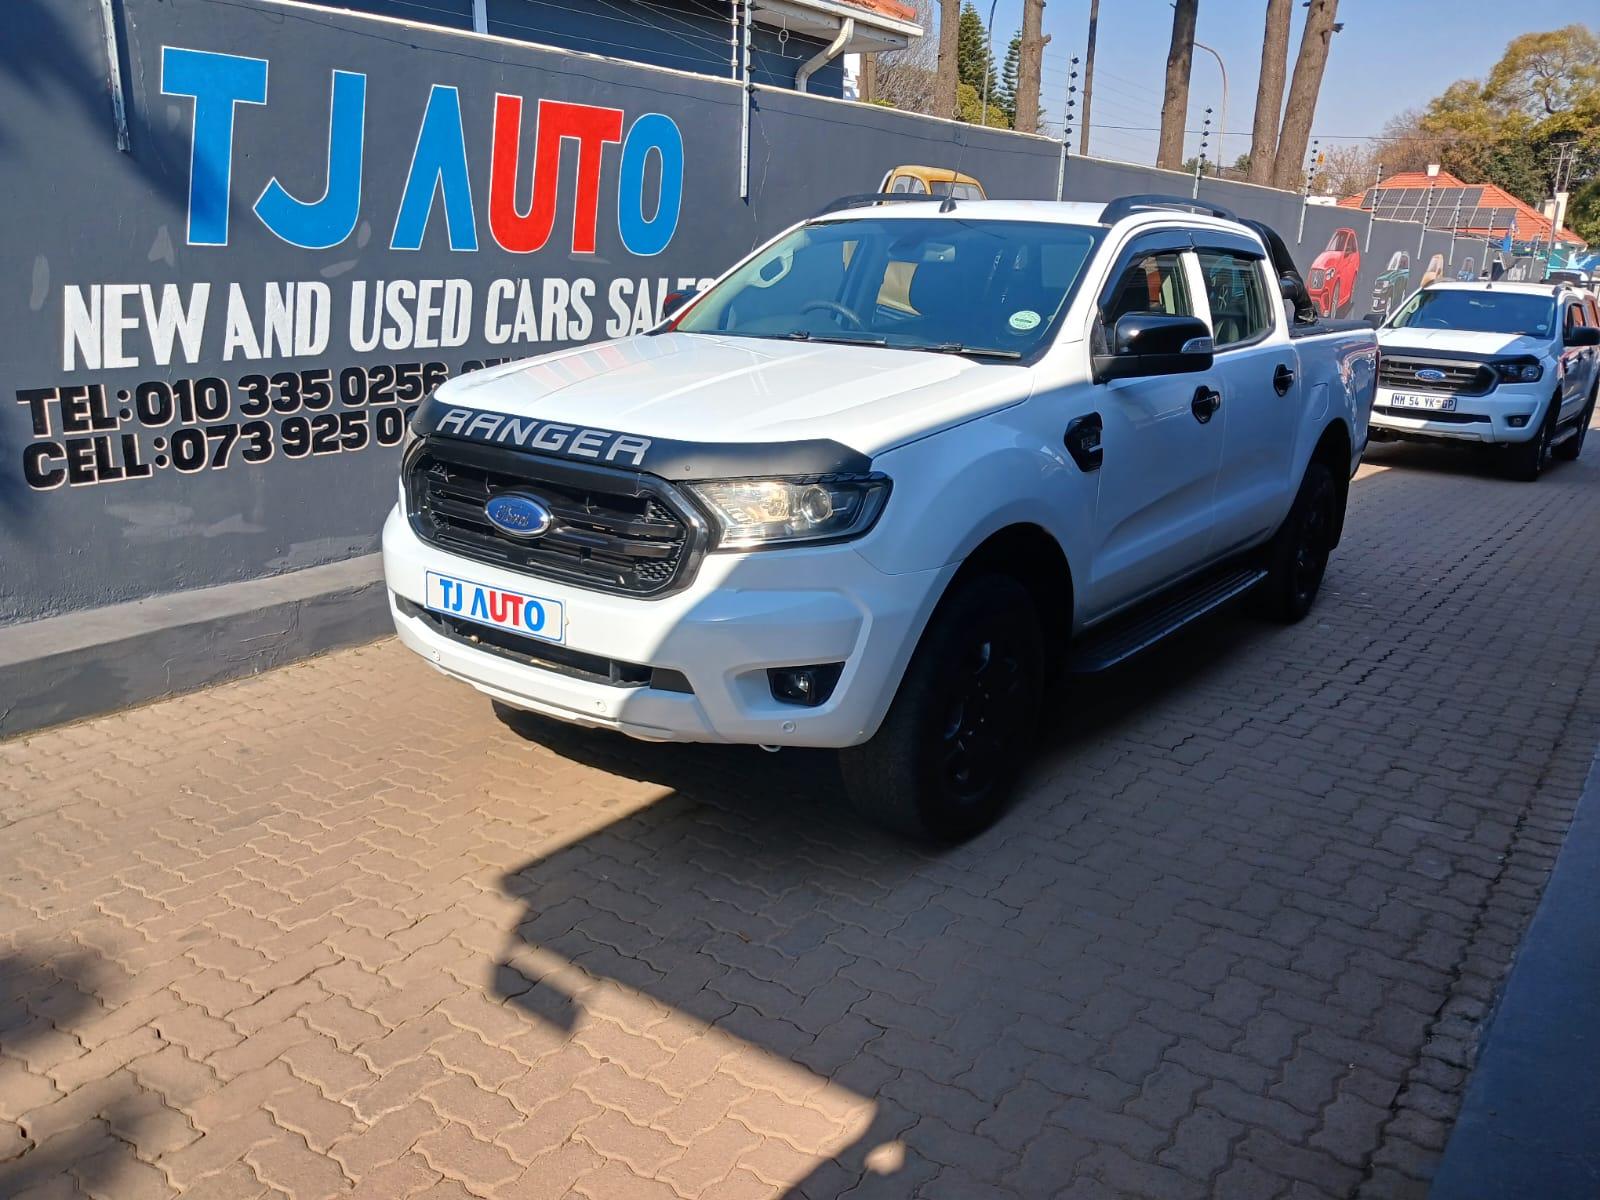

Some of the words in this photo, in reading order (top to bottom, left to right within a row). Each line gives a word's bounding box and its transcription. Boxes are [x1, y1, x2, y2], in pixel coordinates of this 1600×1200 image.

[160, 45, 367, 249] TJ
[389, 83, 685, 257] AUTO
[63, 282, 211, 371] NEW
[223, 281, 331, 361] AND
[350, 278, 473, 352] USED
[484, 277, 596, 344] CARS
[606, 277, 718, 339] SAL
[16, 376, 230, 438] TEL:010
[238, 371, 333, 418] 335
[339, 361, 449, 408] 0256
[436, 408, 652, 466] RANGER
[23, 420, 275, 491] CELL:073
[281, 411, 370, 459] 925
[439, 578, 463, 612] TJ
[470, 587, 546, 632] AUTO
